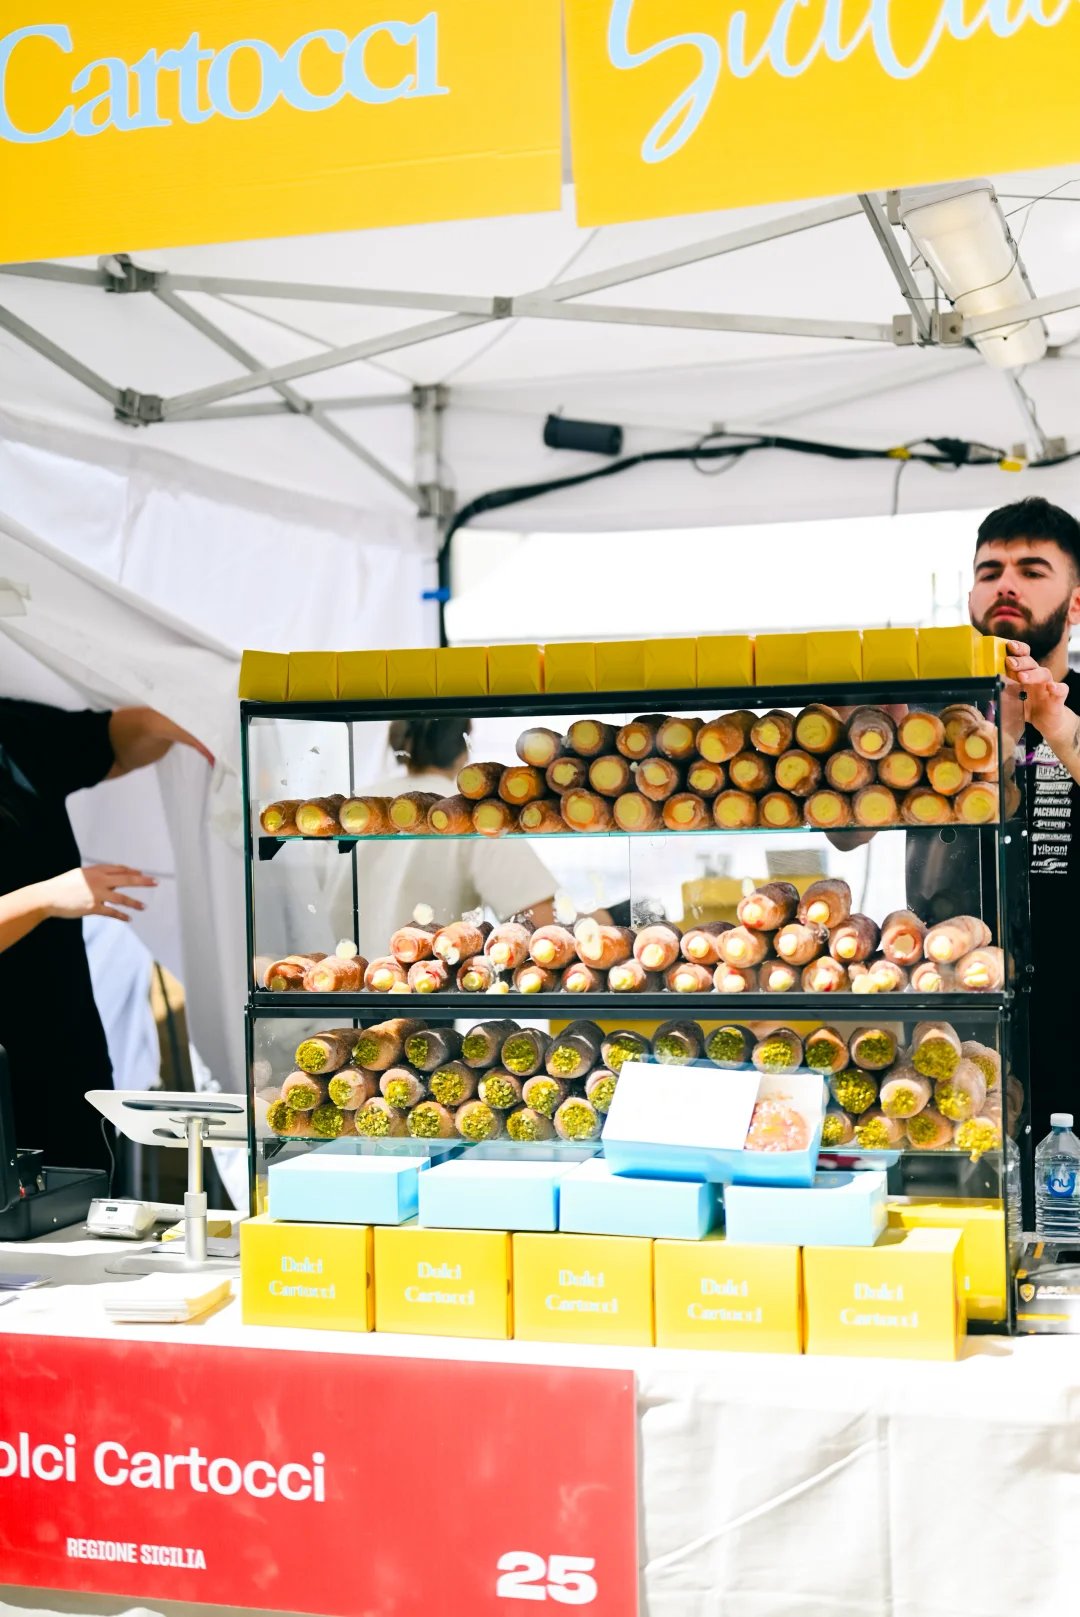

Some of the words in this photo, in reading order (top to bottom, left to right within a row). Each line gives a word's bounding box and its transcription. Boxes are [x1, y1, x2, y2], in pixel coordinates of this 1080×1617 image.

[0, 11, 450, 144] Cartocci
[1033, 807, 1071, 818] PACEMAKER
[1037, 843, 1068, 853] vibrant
[268, 1280, 336, 1299] Cartocci
[404, 1286, 475, 1306] Cartocci
[544, 1294, 618, 1314] Cartocci
[687, 1303, 762, 1323] Cartocci
[839, 1307, 919, 1329] Cartocci
[94, 1441, 325, 1502] Cartocci
[66, 1537, 138, 1564] REGIONE
[140, 1544, 206, 1570] SICILIA
[496, 1550, 598, 1605] 25
